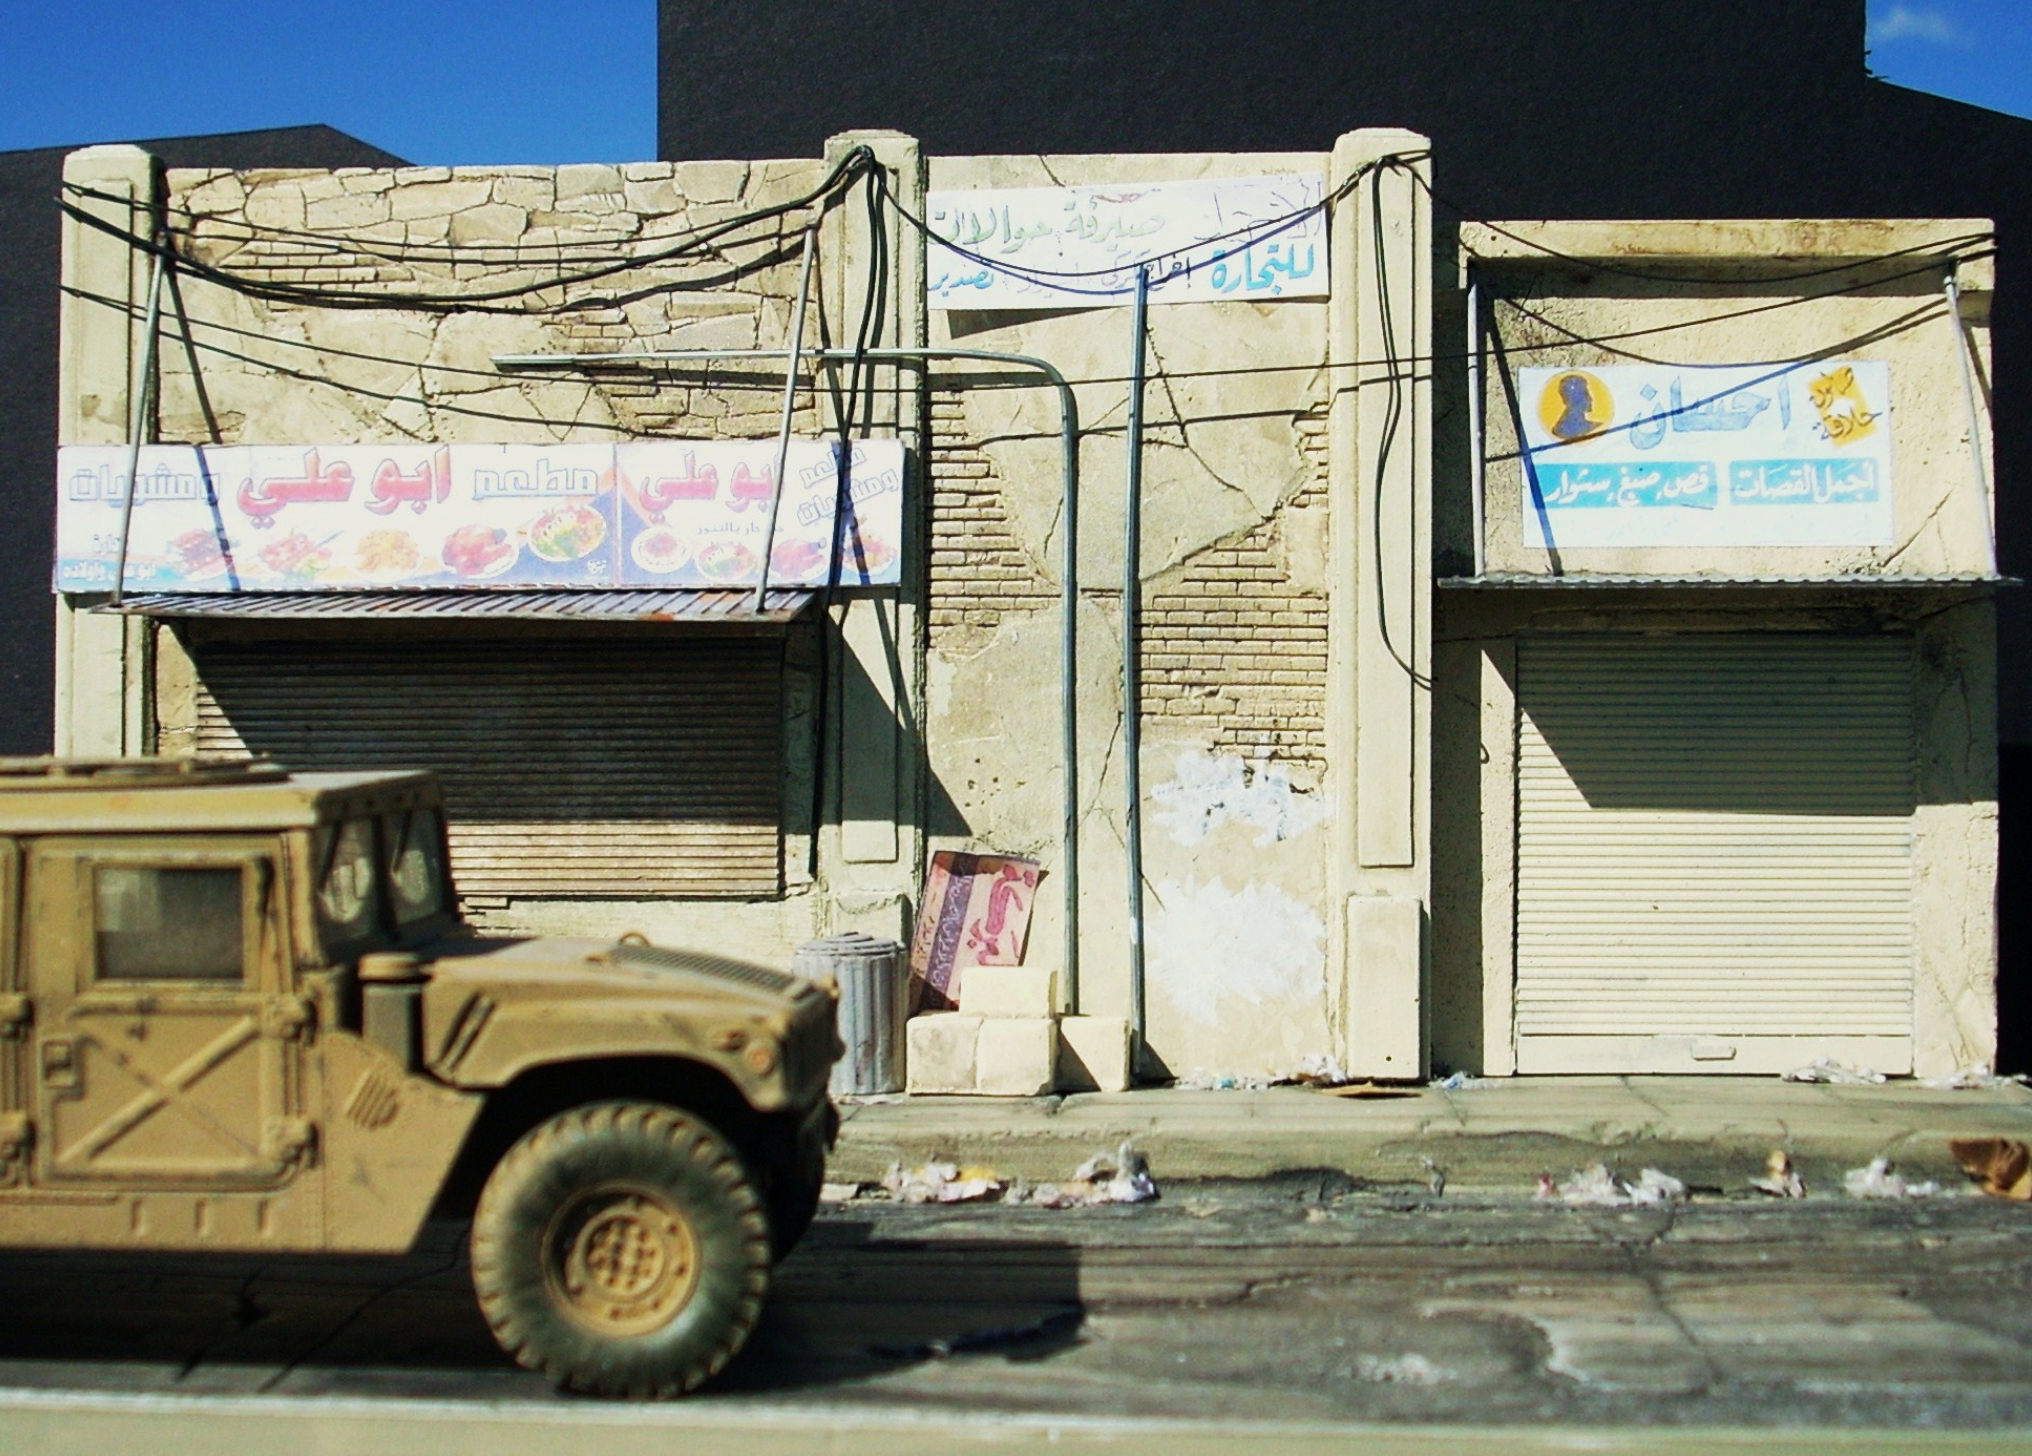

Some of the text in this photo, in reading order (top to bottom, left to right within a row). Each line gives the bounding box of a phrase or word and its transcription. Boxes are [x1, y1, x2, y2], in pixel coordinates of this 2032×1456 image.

[1211, 243, 1315, 295] للتجارة
[236, 446, 356, 530] علي
[363, 443, 452, 515] ابو
[472, 457, 601, 501] مطعم
[639, 449, 785, 526] بو علي
[796, 467, 899, 527] ومشيات
